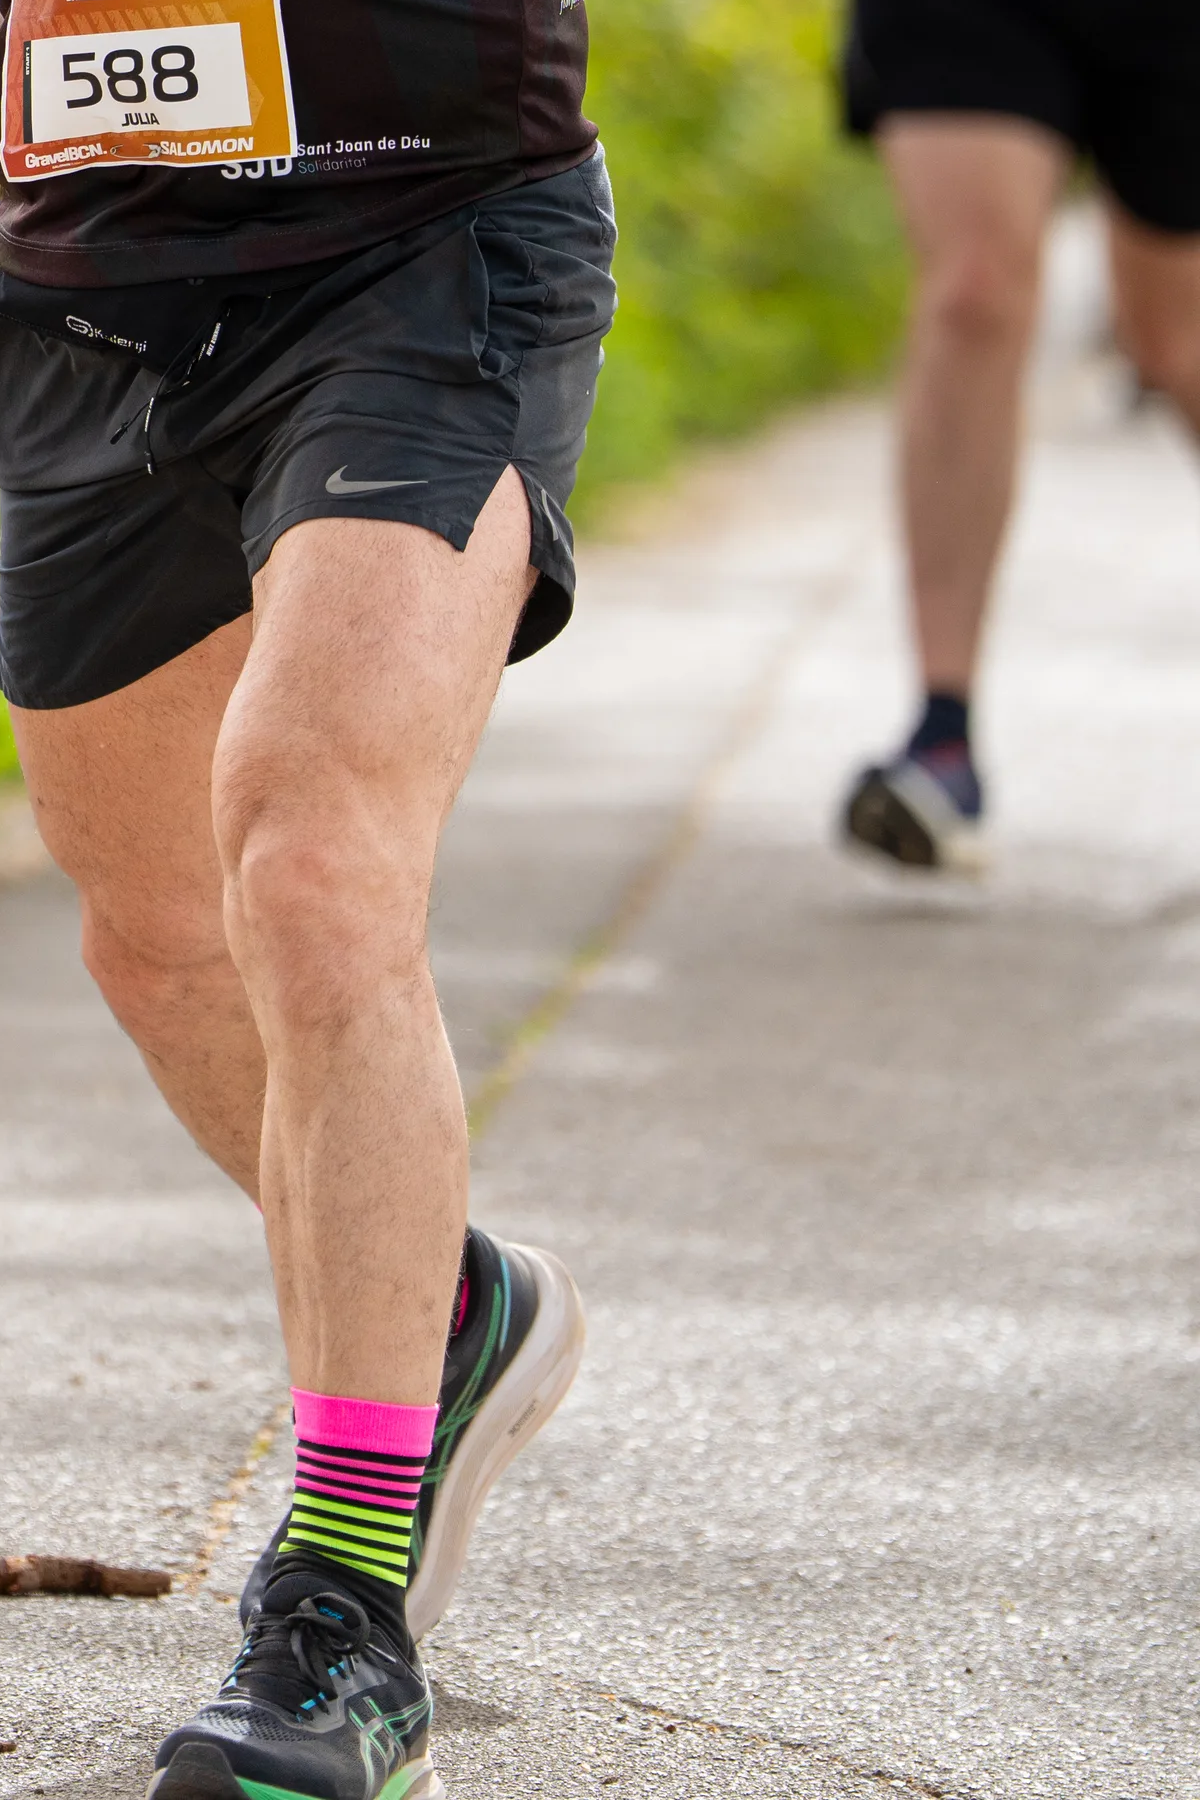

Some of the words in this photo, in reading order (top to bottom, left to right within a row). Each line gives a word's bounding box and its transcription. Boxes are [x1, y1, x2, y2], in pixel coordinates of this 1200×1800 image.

[63, 45, 199, 109] 588
[122, 113, 160, 127] JULIA
[160, 137, 254, 157] SALOMON
[297, 142, 330, 156] Sant
[335, 139, 373, 154] Joan
[377, 136, 396, 150] de
[401, 134, 430, 149] Déu
[298, 156, 367, 174] Solidaritat
